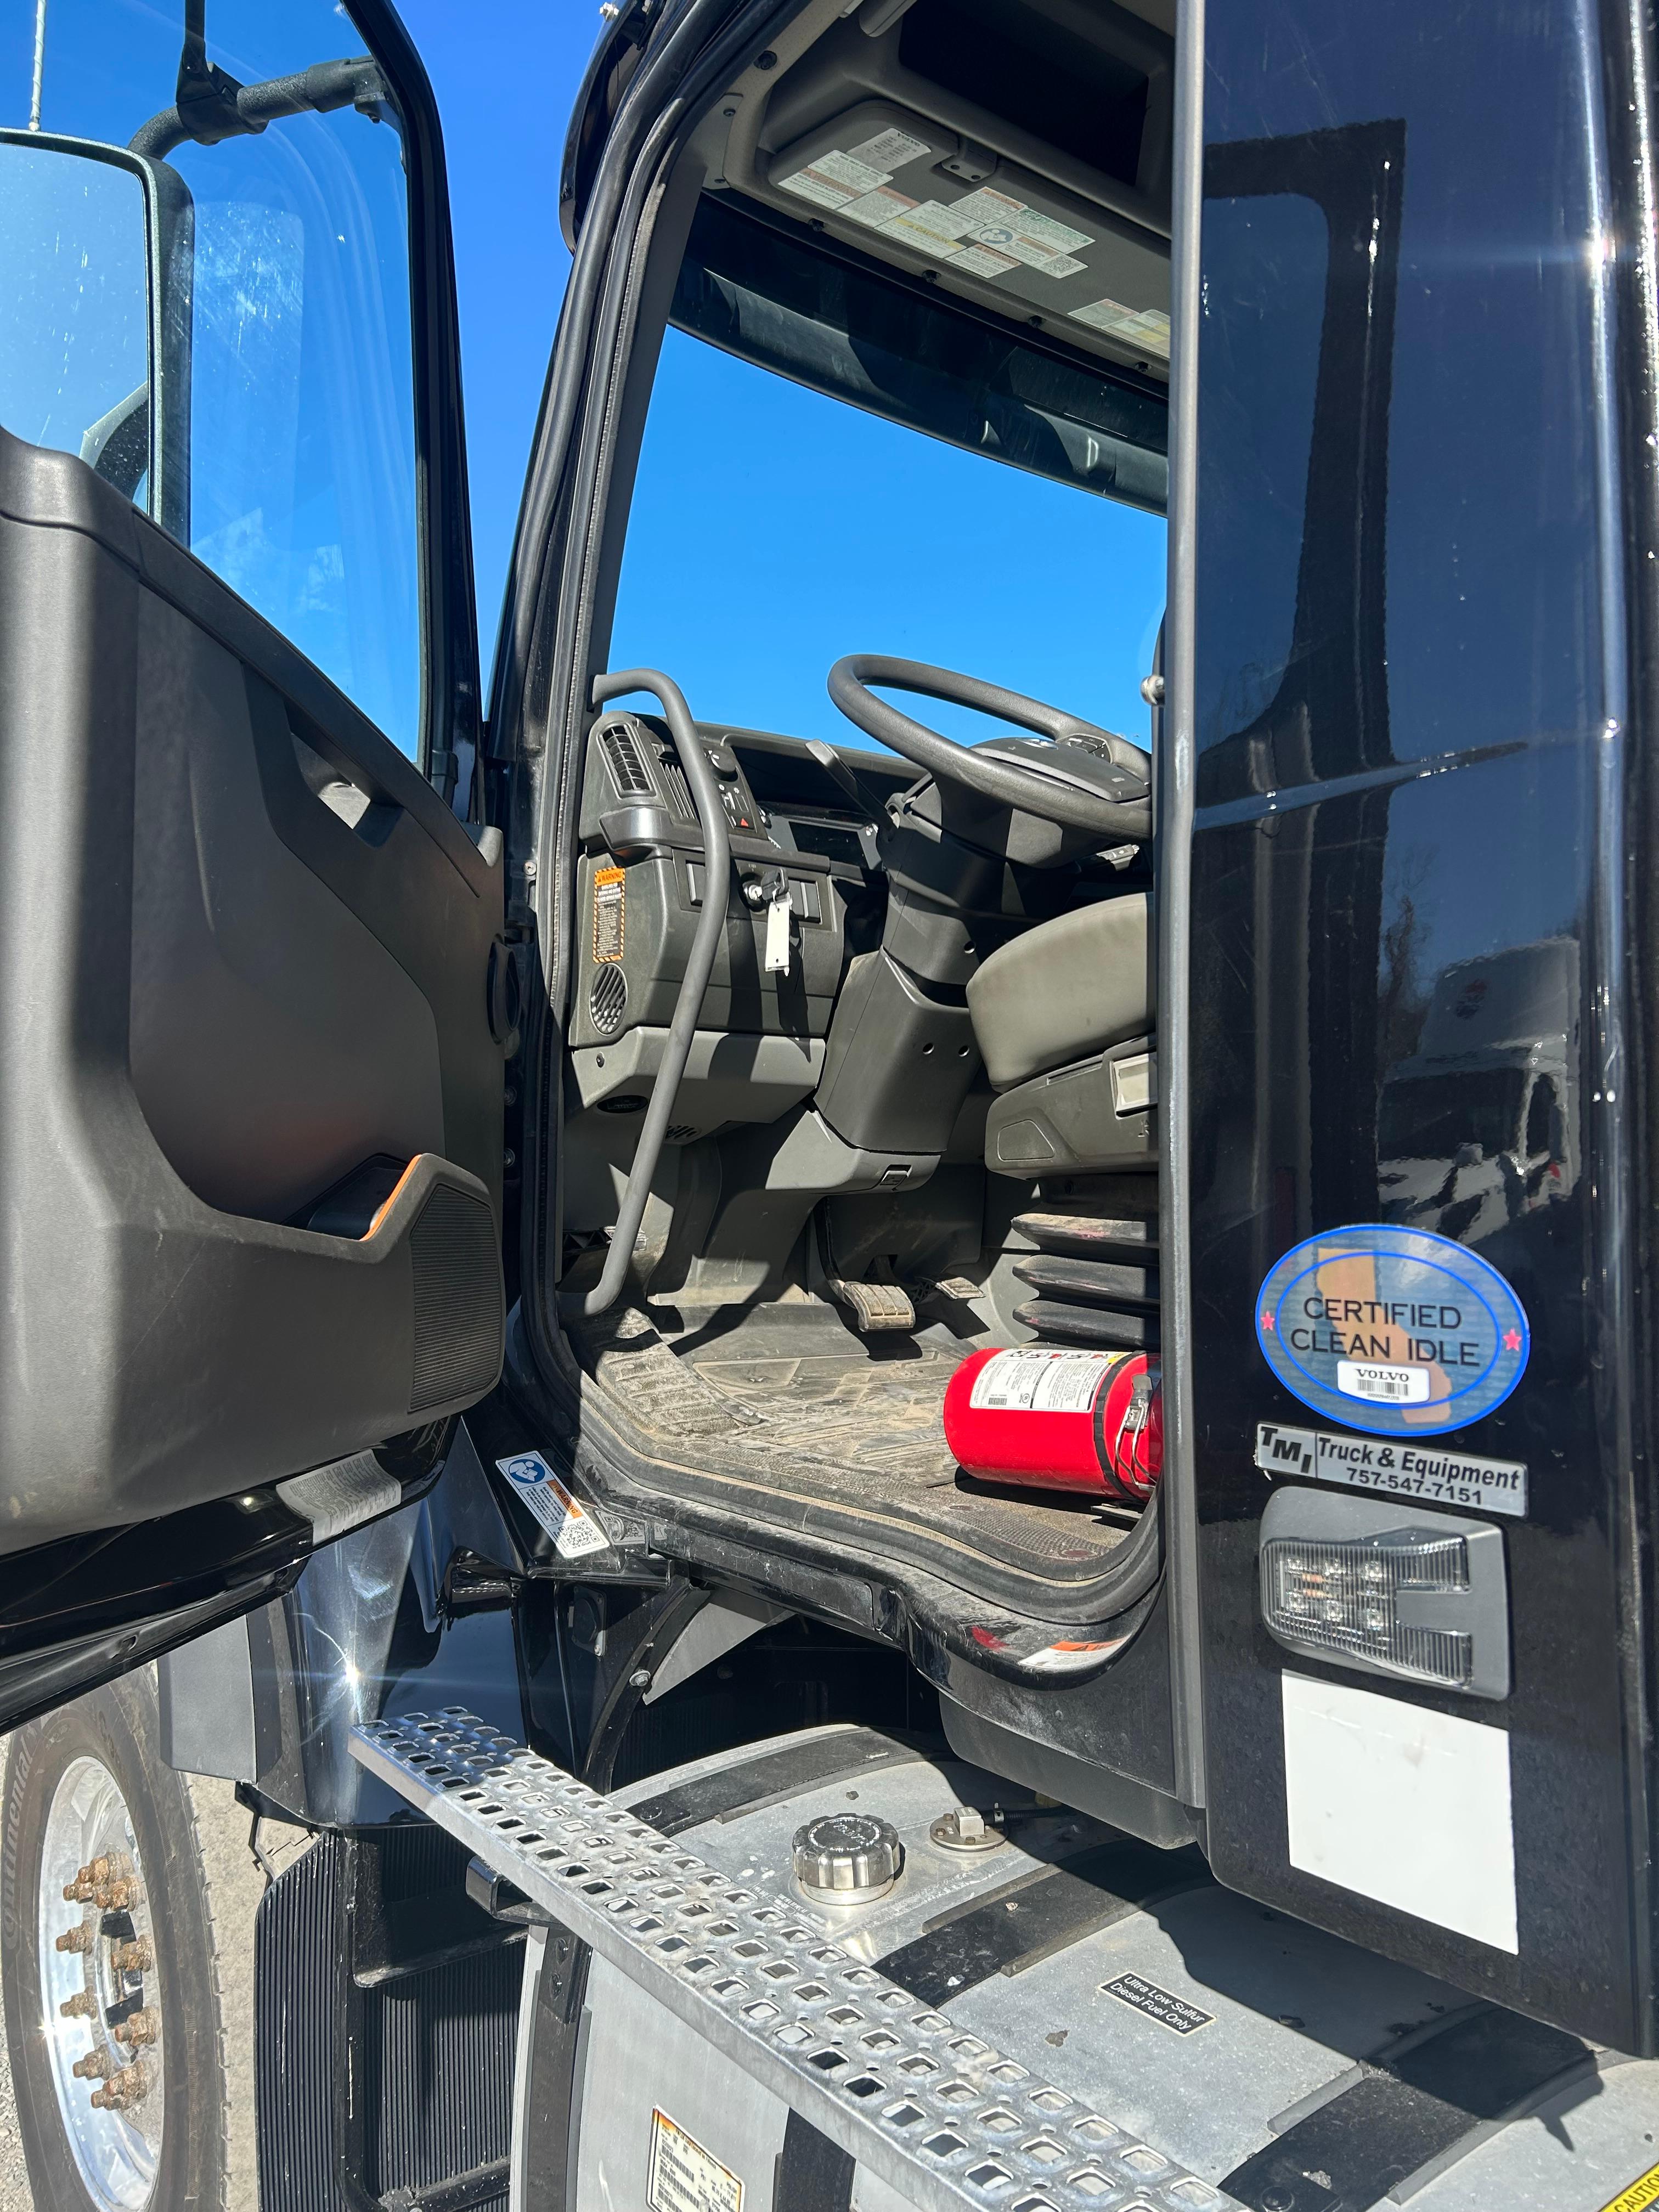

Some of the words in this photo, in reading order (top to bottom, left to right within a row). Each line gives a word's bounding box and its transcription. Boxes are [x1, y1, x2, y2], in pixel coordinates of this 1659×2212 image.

[602, 871, 622, 881] WARNING
[1304, 1297, 1462, 1330] CERTIFIED
[1290, 1329, 1390, 1358] CLEAN
[1407, 1338, 1480, 1367] IDLE
[1355, 1368, 1409, 1383] VOLVO
[1260, 1426, 1312, 1474] TMI
[1319, 1437, 1373, 1467] Truck
[1377, 1447, 1396, 1469] &
[1401, 1451, 1521, 1491] Equipment
[556, 1489, 578, 1514] WARNING
[1346, 1466, 1482, 1505] 757-547-7151
[1110, 1982, 1146, 2003] Diesel
[1141, 2000, 1169, 2016] Fuel
[1165, 2013, 1192, 2030] Only
[1124, 1976, 1149, 1993] Ultra
[1148, 1989, 1173, 2005] Low
[1170, 2002, 1205, 2022] Sulfur
[1614, 2170, 1659, 2212] CAUTIO
